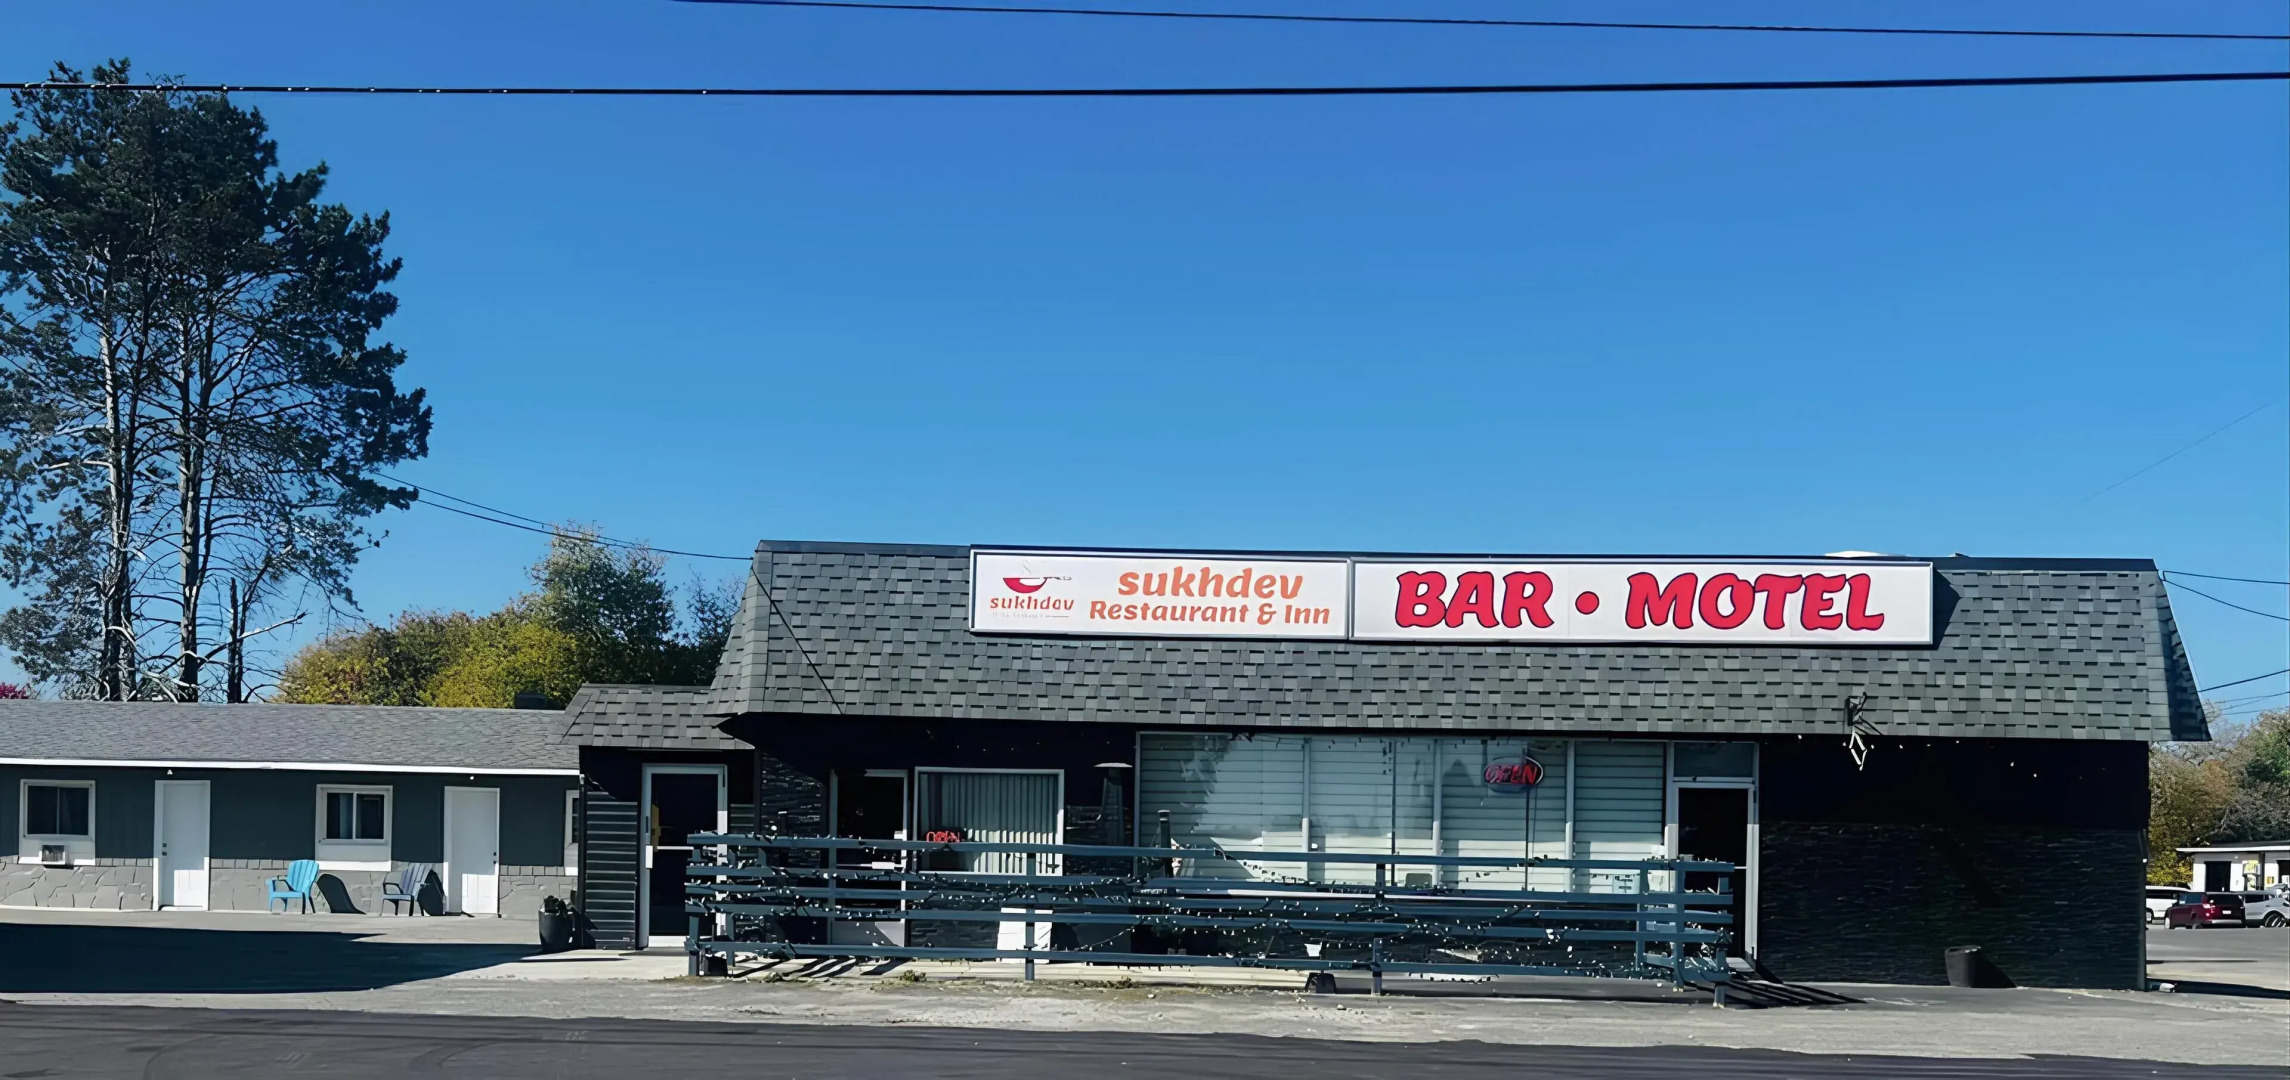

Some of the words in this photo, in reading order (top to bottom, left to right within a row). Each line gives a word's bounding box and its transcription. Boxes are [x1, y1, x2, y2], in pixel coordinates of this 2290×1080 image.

[1118, 566, 1304, 599] sukhdev
[1089, 600, 1249, 622] Restaurant
[1257, 604, 1276, 625] &
[1284, 605, 1330, 624] Inn
[1395, 571, 1554, 628] BAR
[1625, 572, 1885, 631] MOTEL
